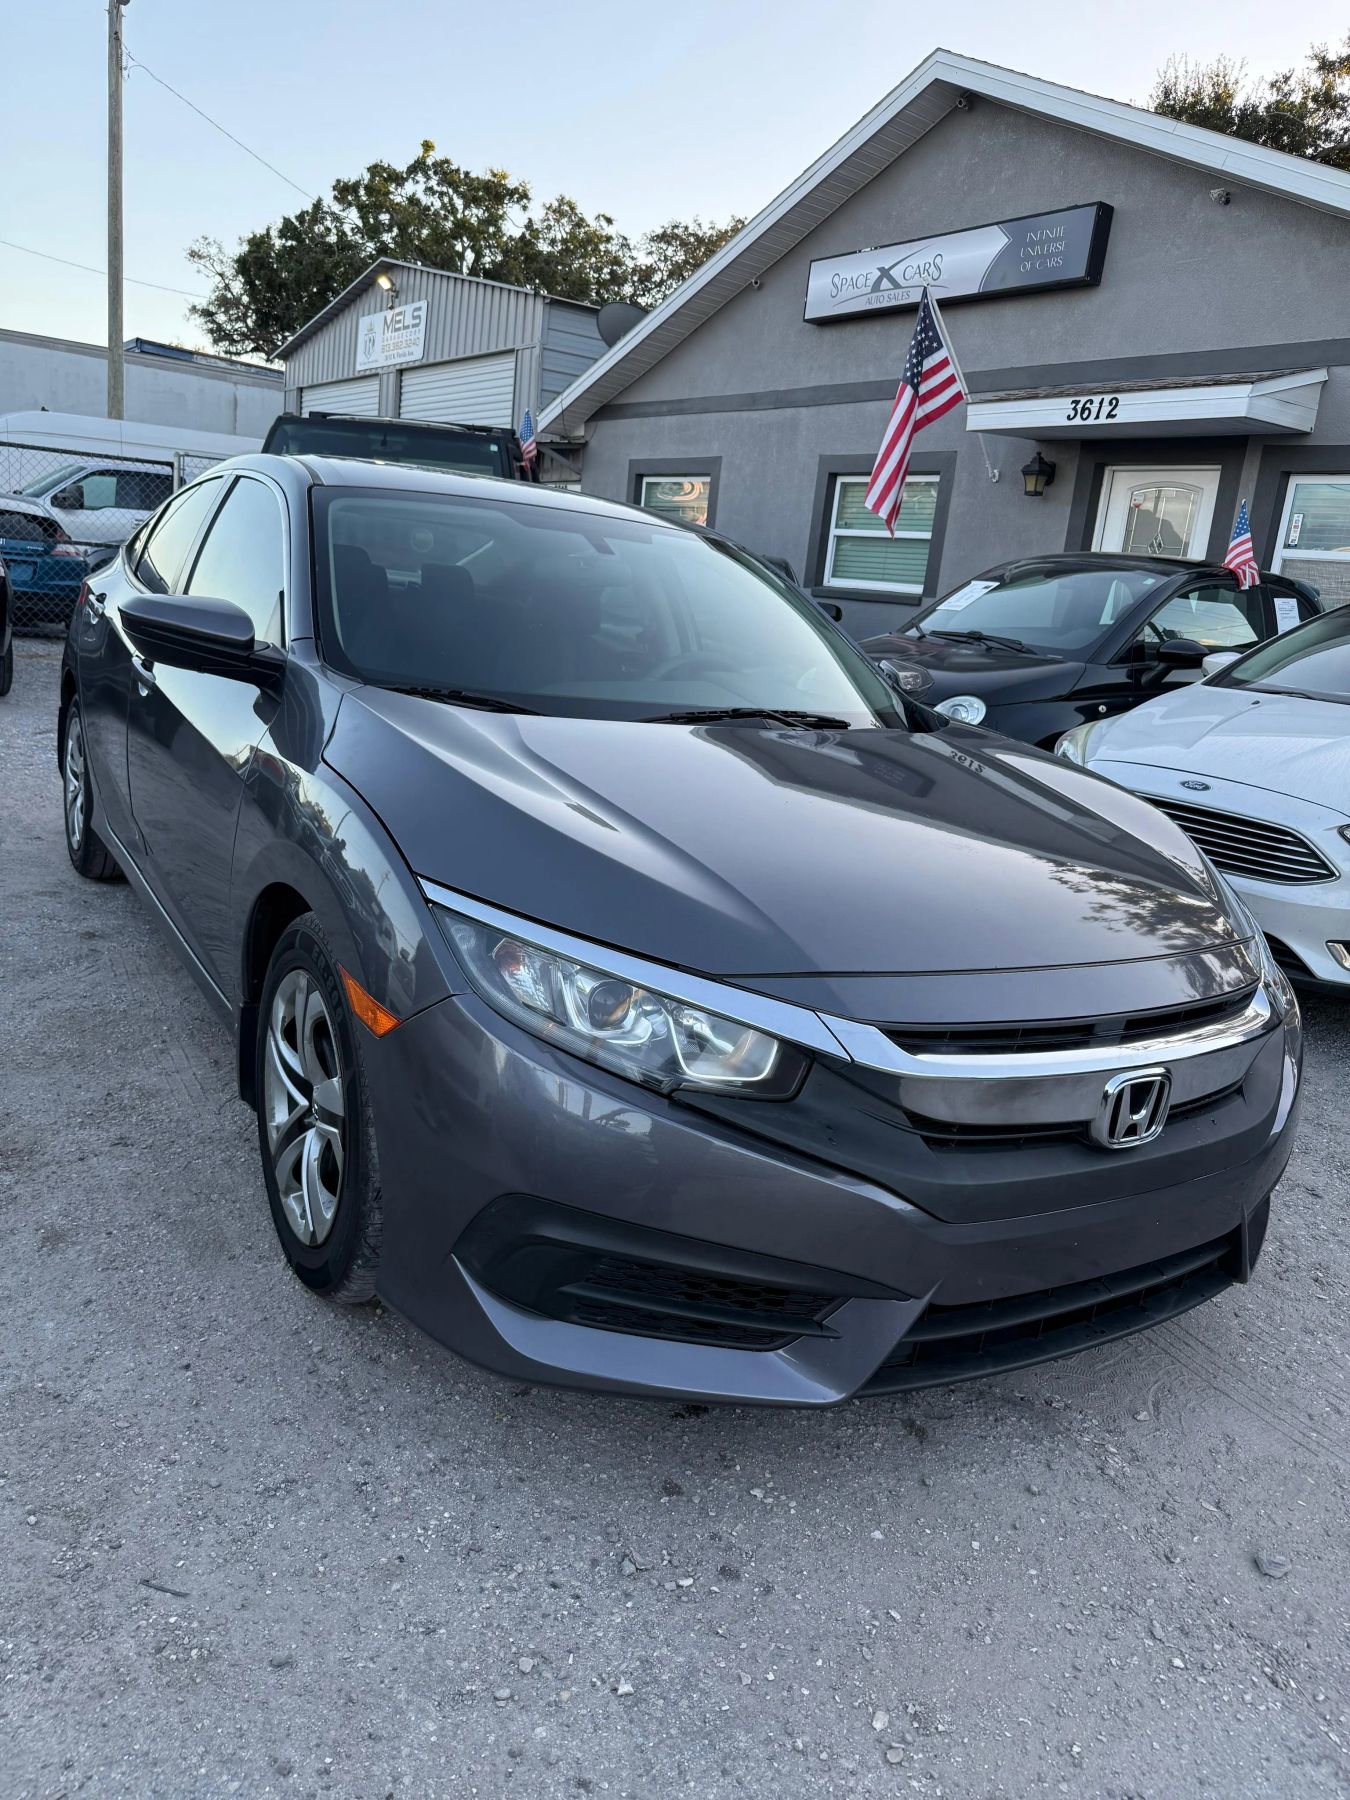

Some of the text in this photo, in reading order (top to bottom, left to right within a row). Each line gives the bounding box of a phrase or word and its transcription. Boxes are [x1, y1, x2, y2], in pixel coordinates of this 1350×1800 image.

[830, 271, 873, 299] SPACE
[903, 253, 943, 281] CARS
[865, 290, 911, 306] AUTO SALES
[382, 306, 422, 336] MELS
[1066, 396, 1120, 421] 3612
